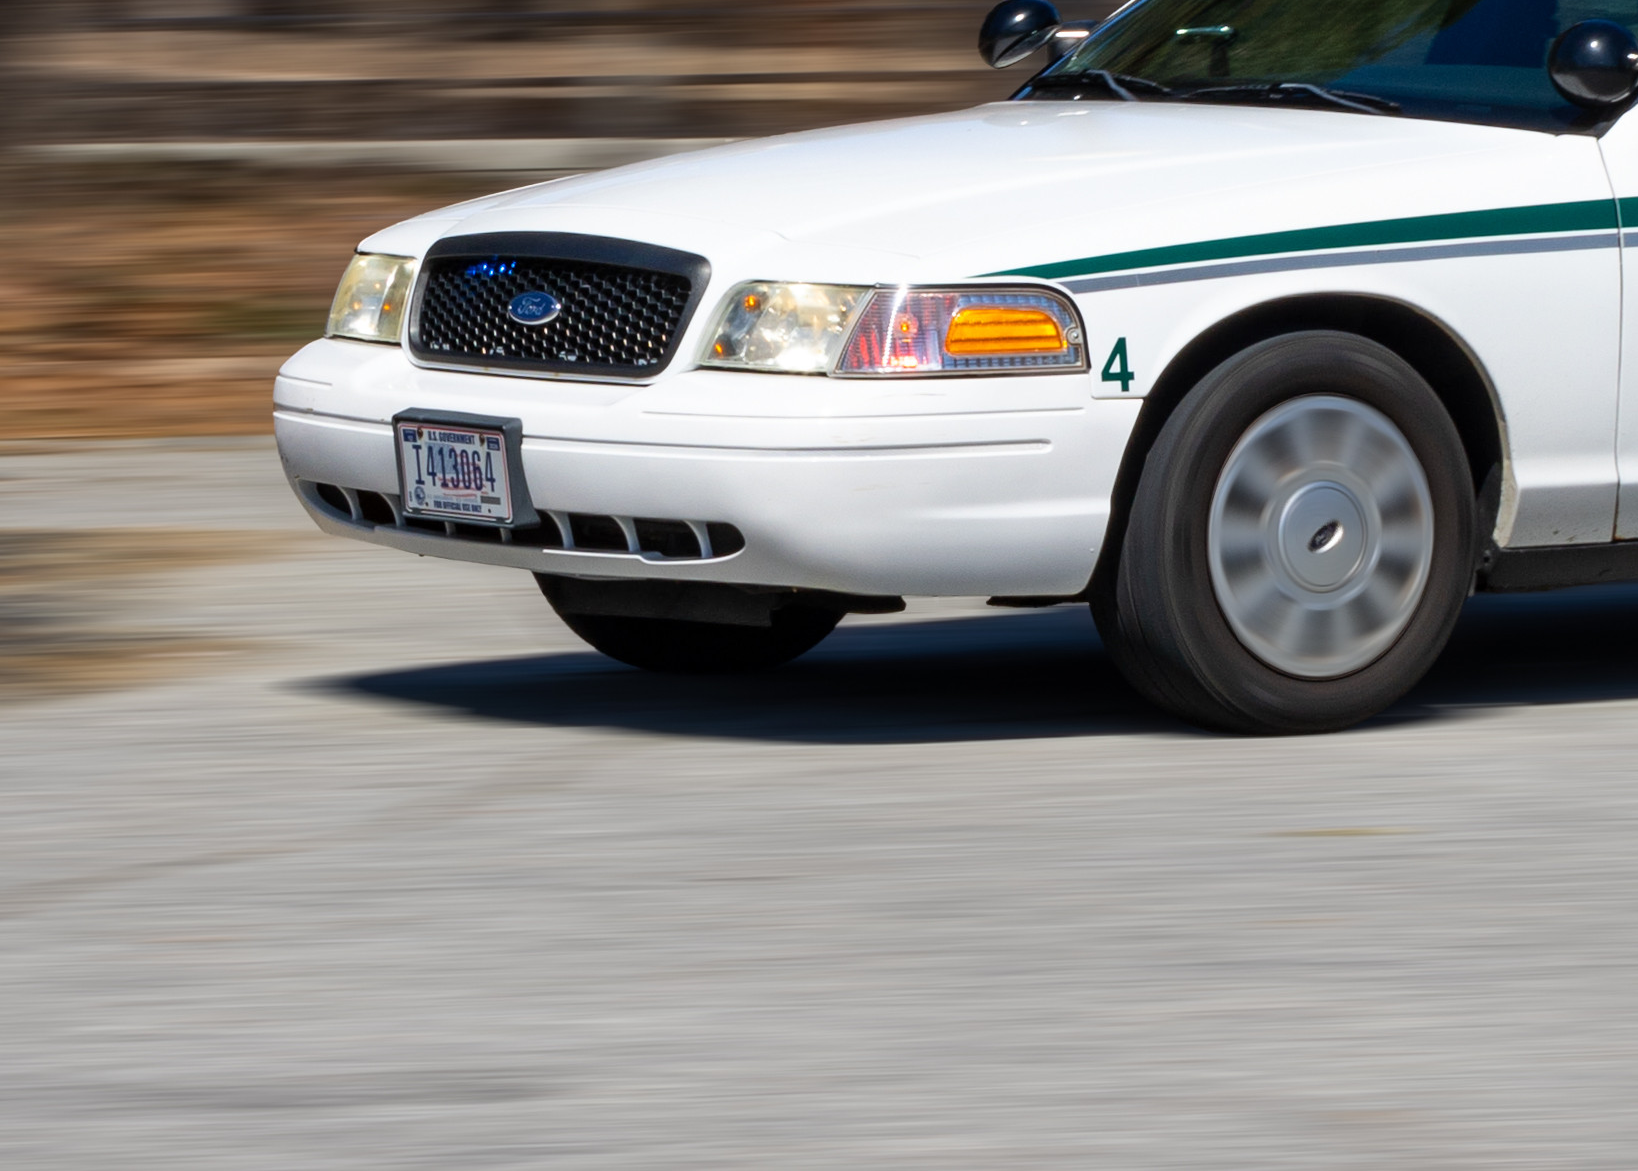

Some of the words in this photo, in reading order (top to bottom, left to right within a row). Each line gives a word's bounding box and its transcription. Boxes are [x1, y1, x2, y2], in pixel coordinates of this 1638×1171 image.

[517, 296, 546, 317] Ford
[1101, 337, 1135, 392] 4
[439, 431, 475, 445] GOVERNMENT
[412, 444, 496, 493] I413064
